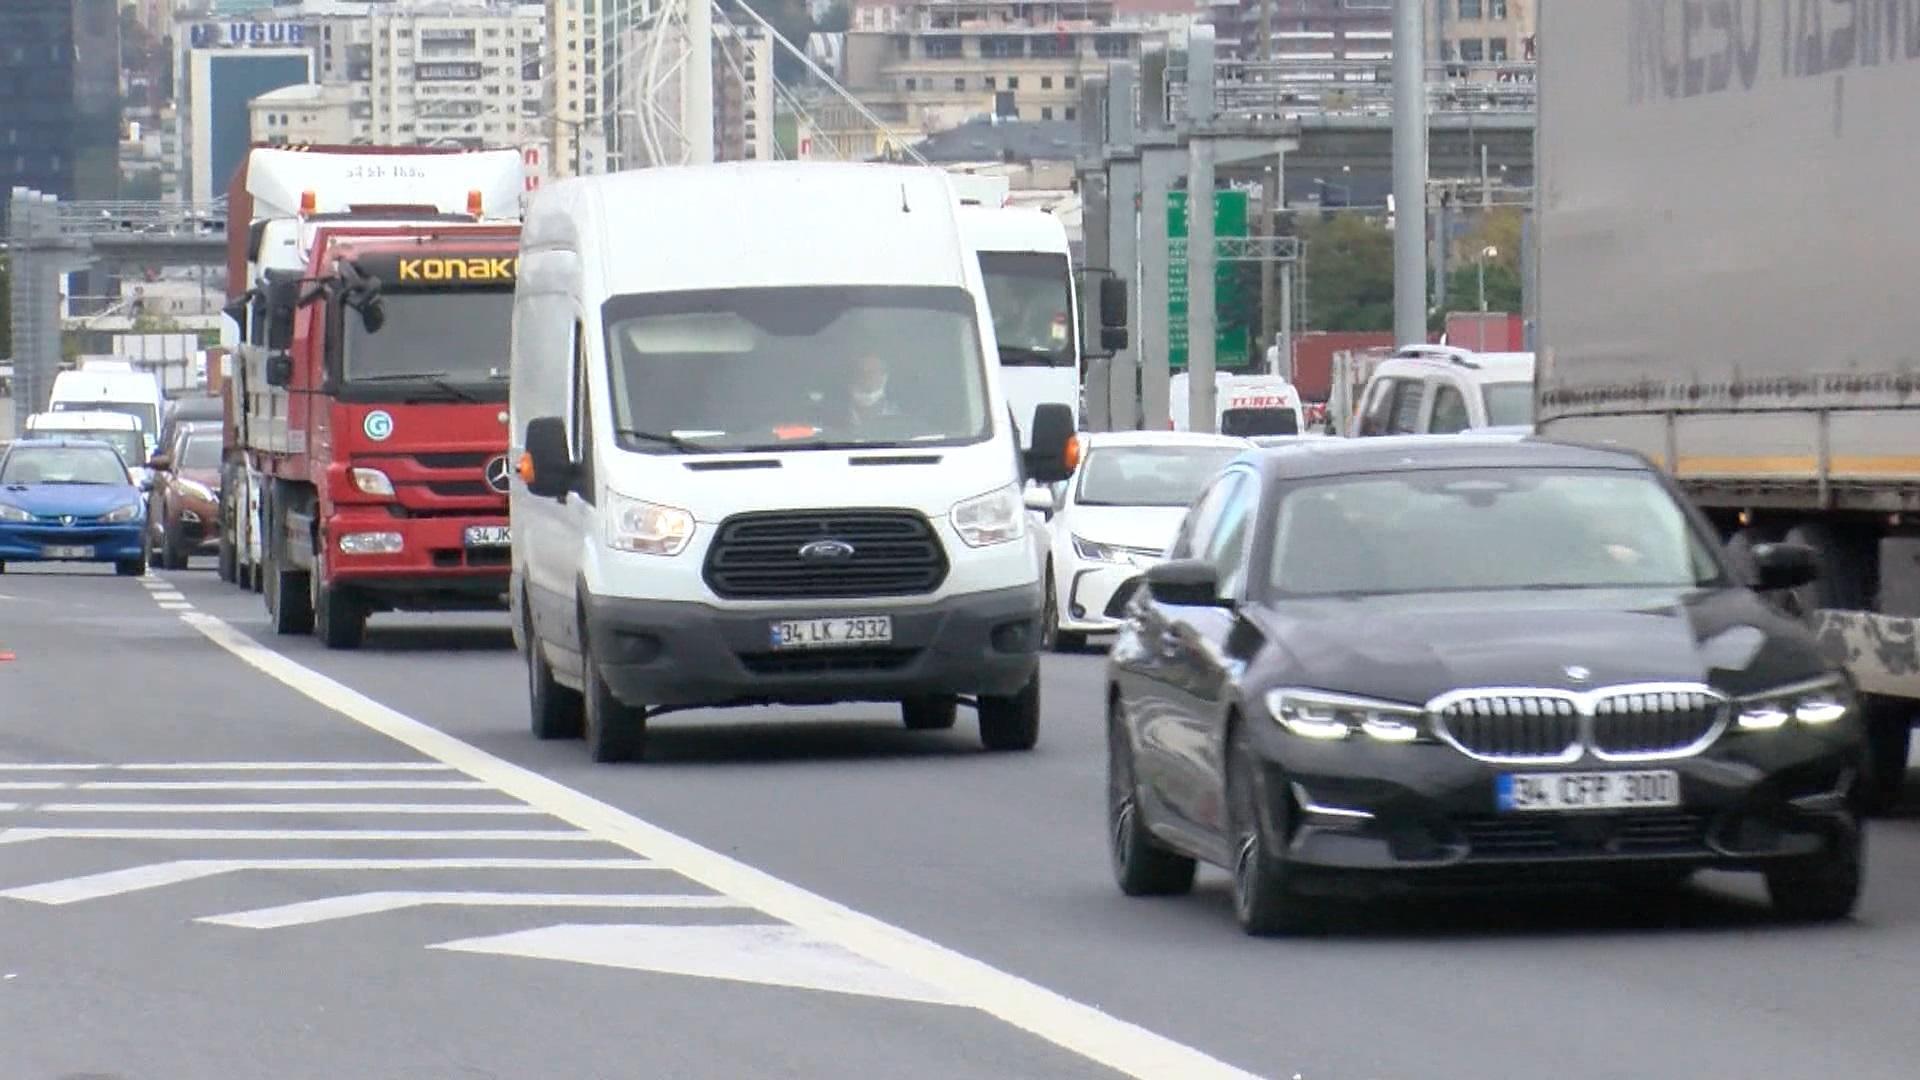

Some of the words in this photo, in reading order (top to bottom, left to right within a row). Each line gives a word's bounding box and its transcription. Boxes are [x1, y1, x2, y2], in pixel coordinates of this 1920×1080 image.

[473, 528, 489, 541] 34
[783, 623, 803, 642] 34
[810, 621, 833, 641] LK
[845, 619, 889, 640] 2932
[1515, 777, 1546, 804] 34
[1558, 775, 1610, 803] CFP
[1624, 773, 1674, 802] 300
